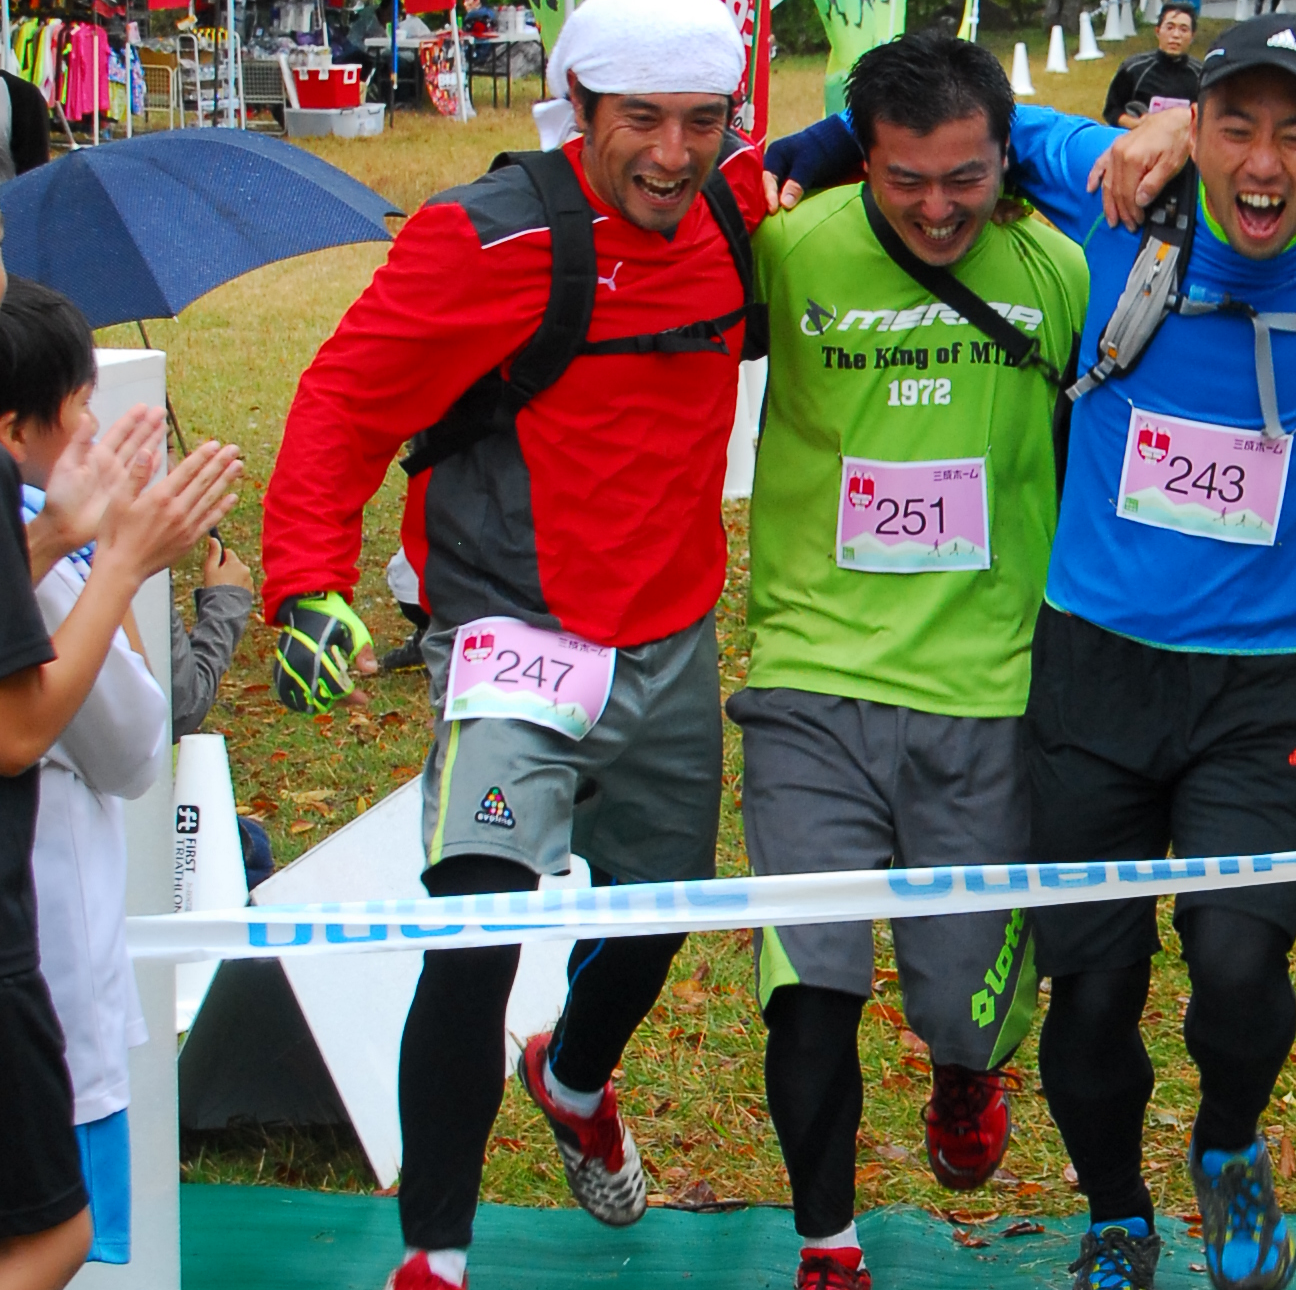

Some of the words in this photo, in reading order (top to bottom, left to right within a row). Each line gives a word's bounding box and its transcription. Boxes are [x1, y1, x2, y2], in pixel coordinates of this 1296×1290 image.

[837, 301, 1043, 332] MERA
[822, 345, 867, 370] The
[874, 344, 929, 370] King
[936, 341, 963, 364] of
[887, 378, 951, 407] 1972
[1164, 456, 1246, 503] 243
[875, 497, 945, 535] 251
[493, 650, 574, 692] 247
[184, 838, 197, 874] FIRST
[984, 908, 1024, 995] lott
